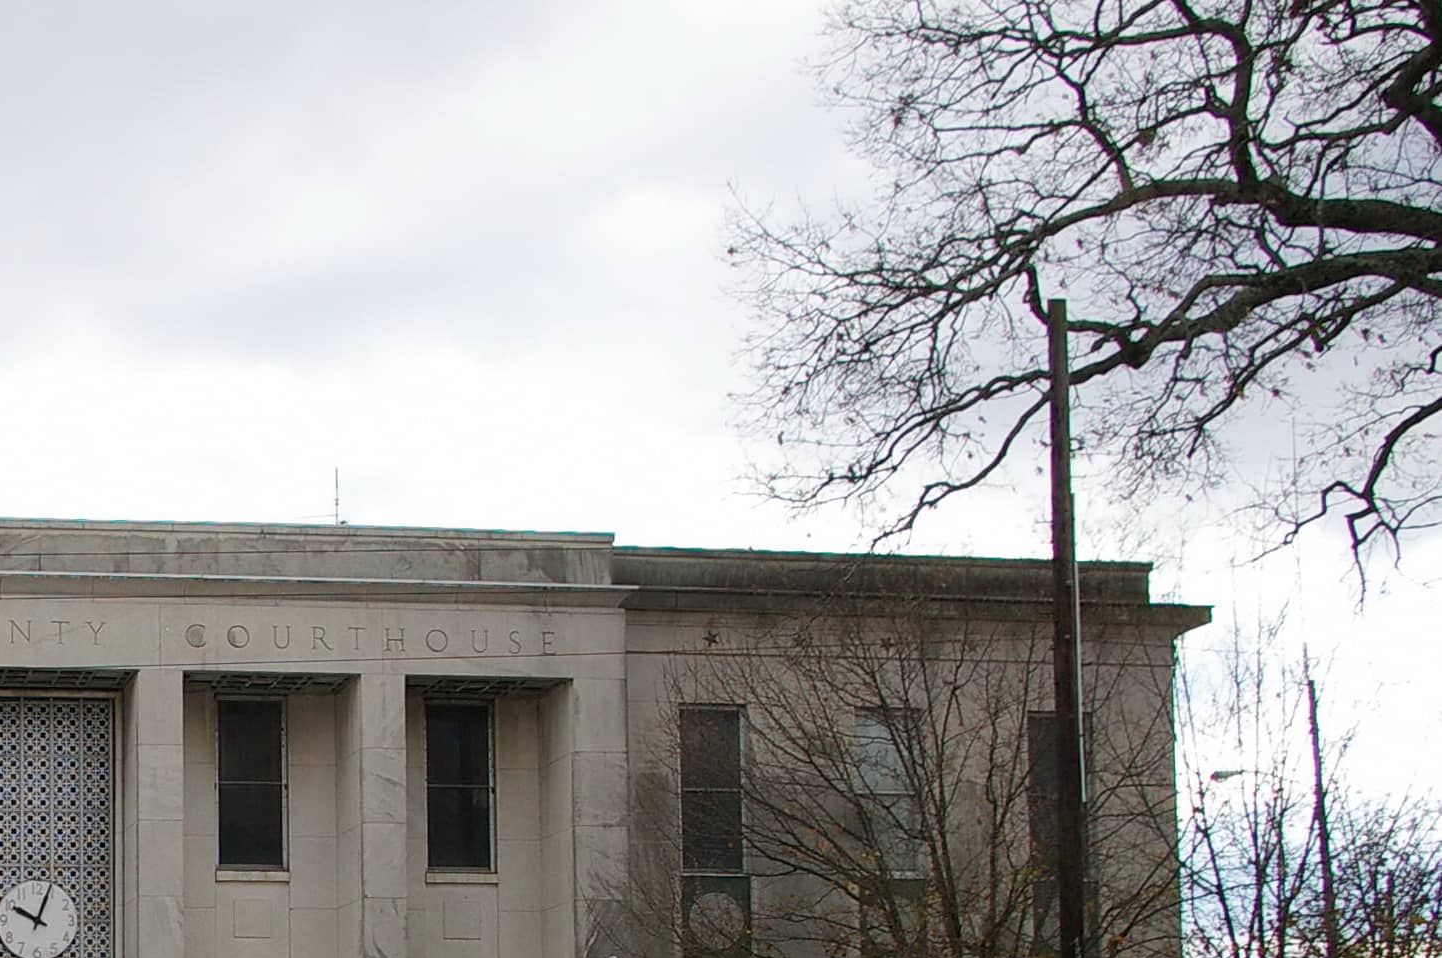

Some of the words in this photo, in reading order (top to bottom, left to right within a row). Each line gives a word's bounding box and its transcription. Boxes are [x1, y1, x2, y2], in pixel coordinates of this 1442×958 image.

[185, 623, 557, 656] COURTHOUSE
[18, 888, 26, 901] 11
[32, 882, 44, 896] 12
[6, 900, 16, 911] 10
[62, 899, 69, 911] 2
[0, 914, 8, 926] 9
[68, 915, 75, 927] 3
[6, 931, 14, 943] 8
[62, 931, 69, 942] 4
[18, 942, 26, 955] 7
[33, 947, 41, 958] 6
[50, 942, 58, 955] 5
